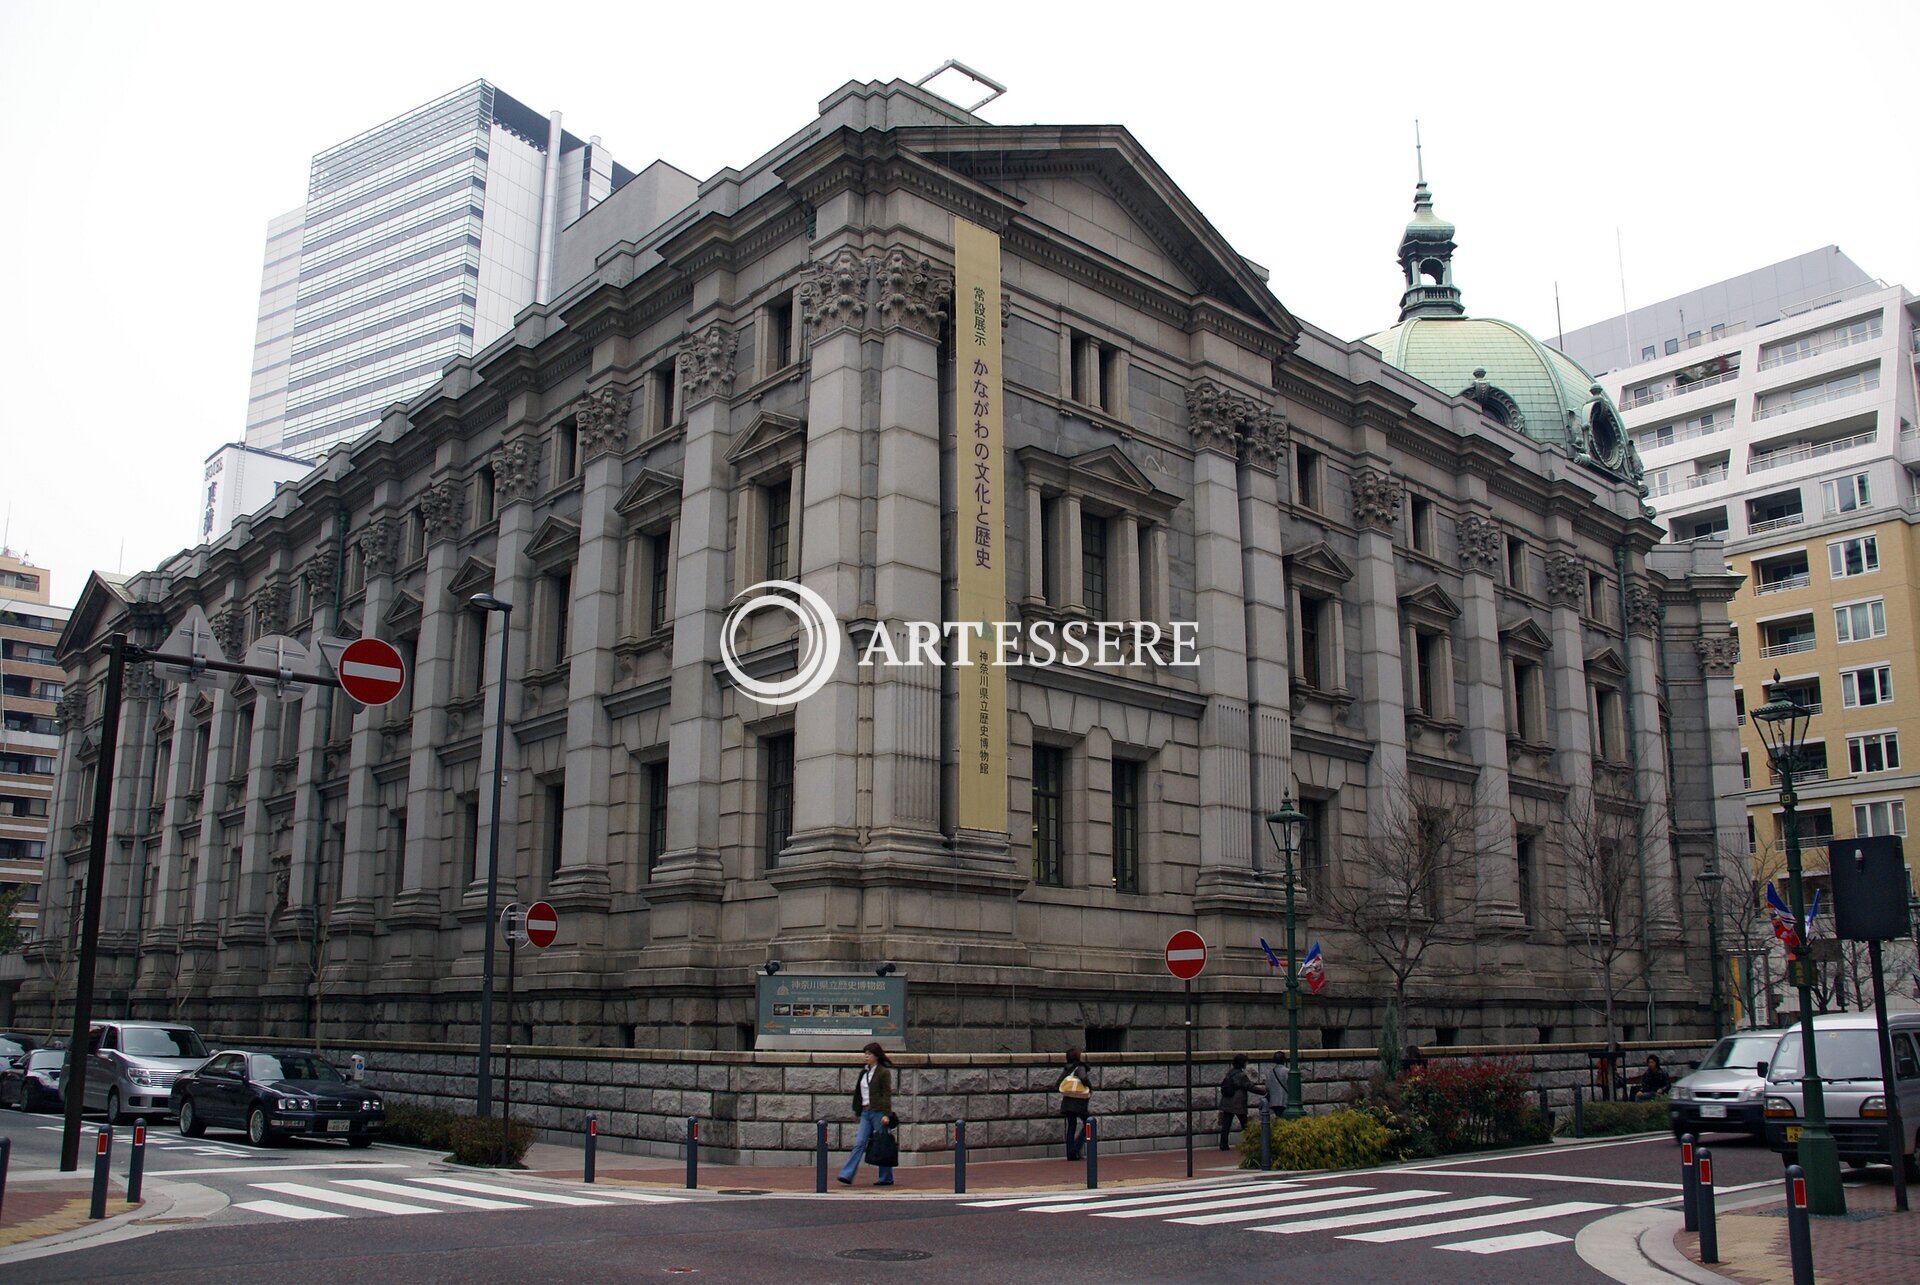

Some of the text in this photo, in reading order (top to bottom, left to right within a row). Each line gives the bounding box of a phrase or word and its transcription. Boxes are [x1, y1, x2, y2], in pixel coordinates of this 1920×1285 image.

[973, 286, 991, 570] 常設展示 かながわの文化と歴史
[979, 650, 990, 775] 神奈川県立歴史博物館
[791, 980, 886, 991] 神奈川県立歴史博物館
